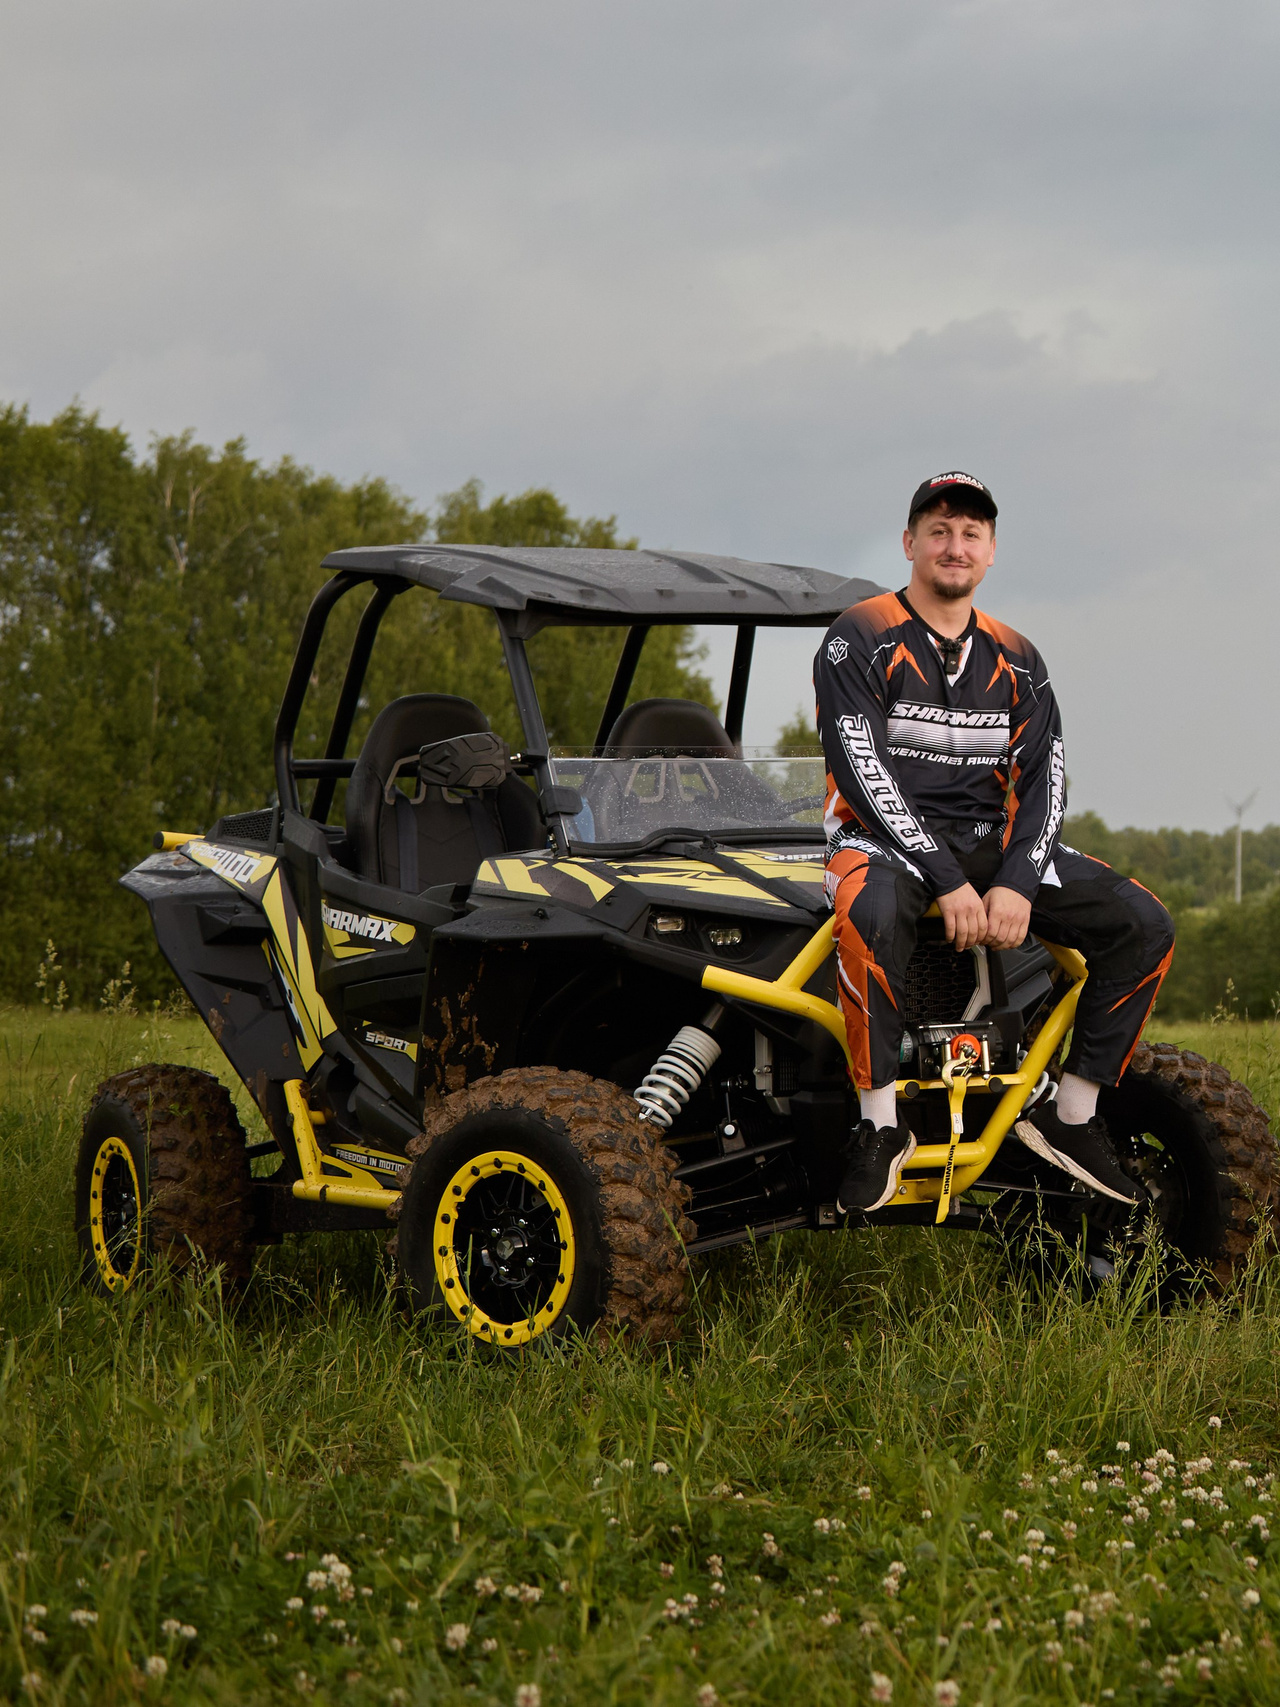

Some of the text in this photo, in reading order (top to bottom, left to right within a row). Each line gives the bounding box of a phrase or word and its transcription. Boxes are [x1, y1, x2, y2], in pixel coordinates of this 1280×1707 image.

[930, 473, 984, 491] SHARMAX
[891, 703, 1011, 727] SHARMAX
[322, 903, 398, 942] SHARMAX
[365, 1031, 410, 1051] SPORT
[336, 1149, 368, 1164] FREEDOM
[370, 1157, 377, 1167] IN
[943, 1144, 956, 1195] NOVAWINCH
